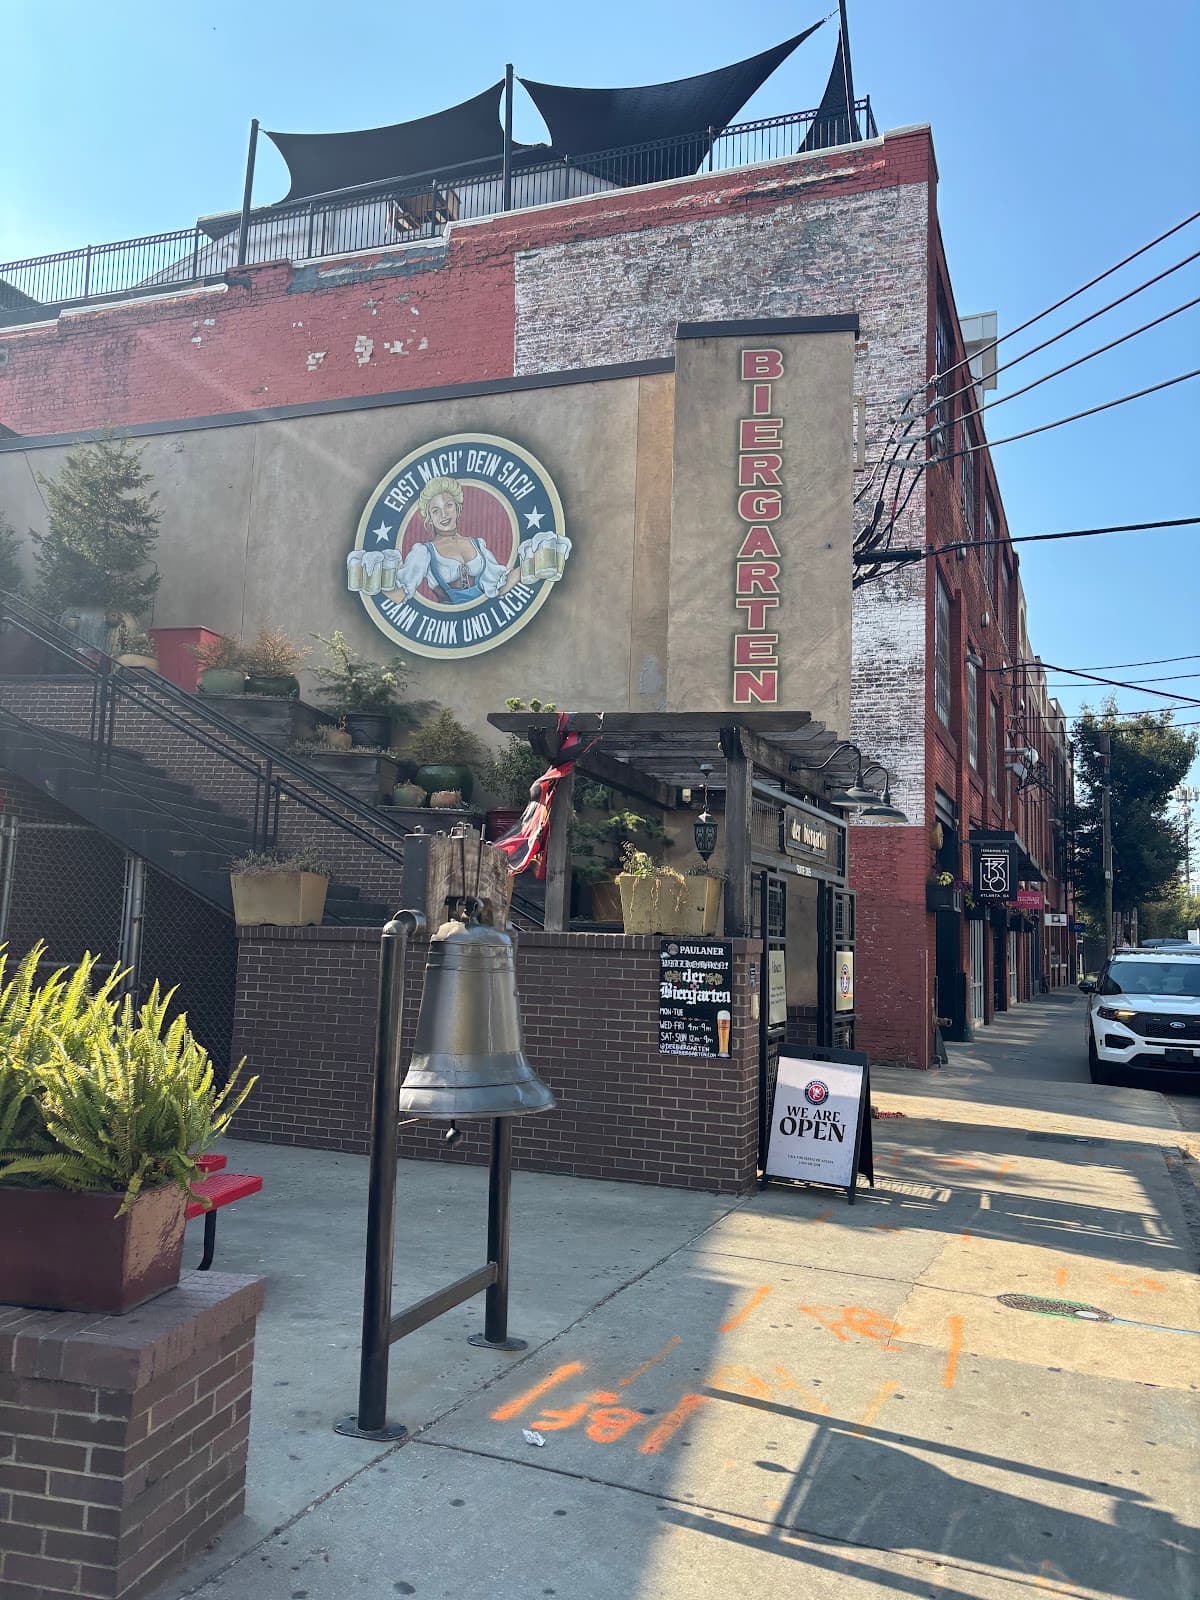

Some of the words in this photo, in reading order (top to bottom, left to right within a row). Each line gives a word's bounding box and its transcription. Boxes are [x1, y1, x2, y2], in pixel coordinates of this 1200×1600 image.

[384, 471, 420, 512] ERST
[417, 451, 463, 483] MACH'
[466, 450, 501, 477] DEIN
[497, 461, 536, 500] SACH
[733, 349, 785, 703] BIERGARTEN
[381, 598, 418, 631] DANN
[416, 614, 457, 645] TRINK
[463, 614, 493, 642] UND
[490, 584, 535, 627] LACH!
[680, 946, 724, 956] PAULANER
[682, 969, 706, 983] der
[660, 982, 731, 1004] Biergarten
[787, 1105, 808, 1119] WE
[813, 1109, 840, 1122] ARE
[779, 1117, 846, 1143] OPEN
